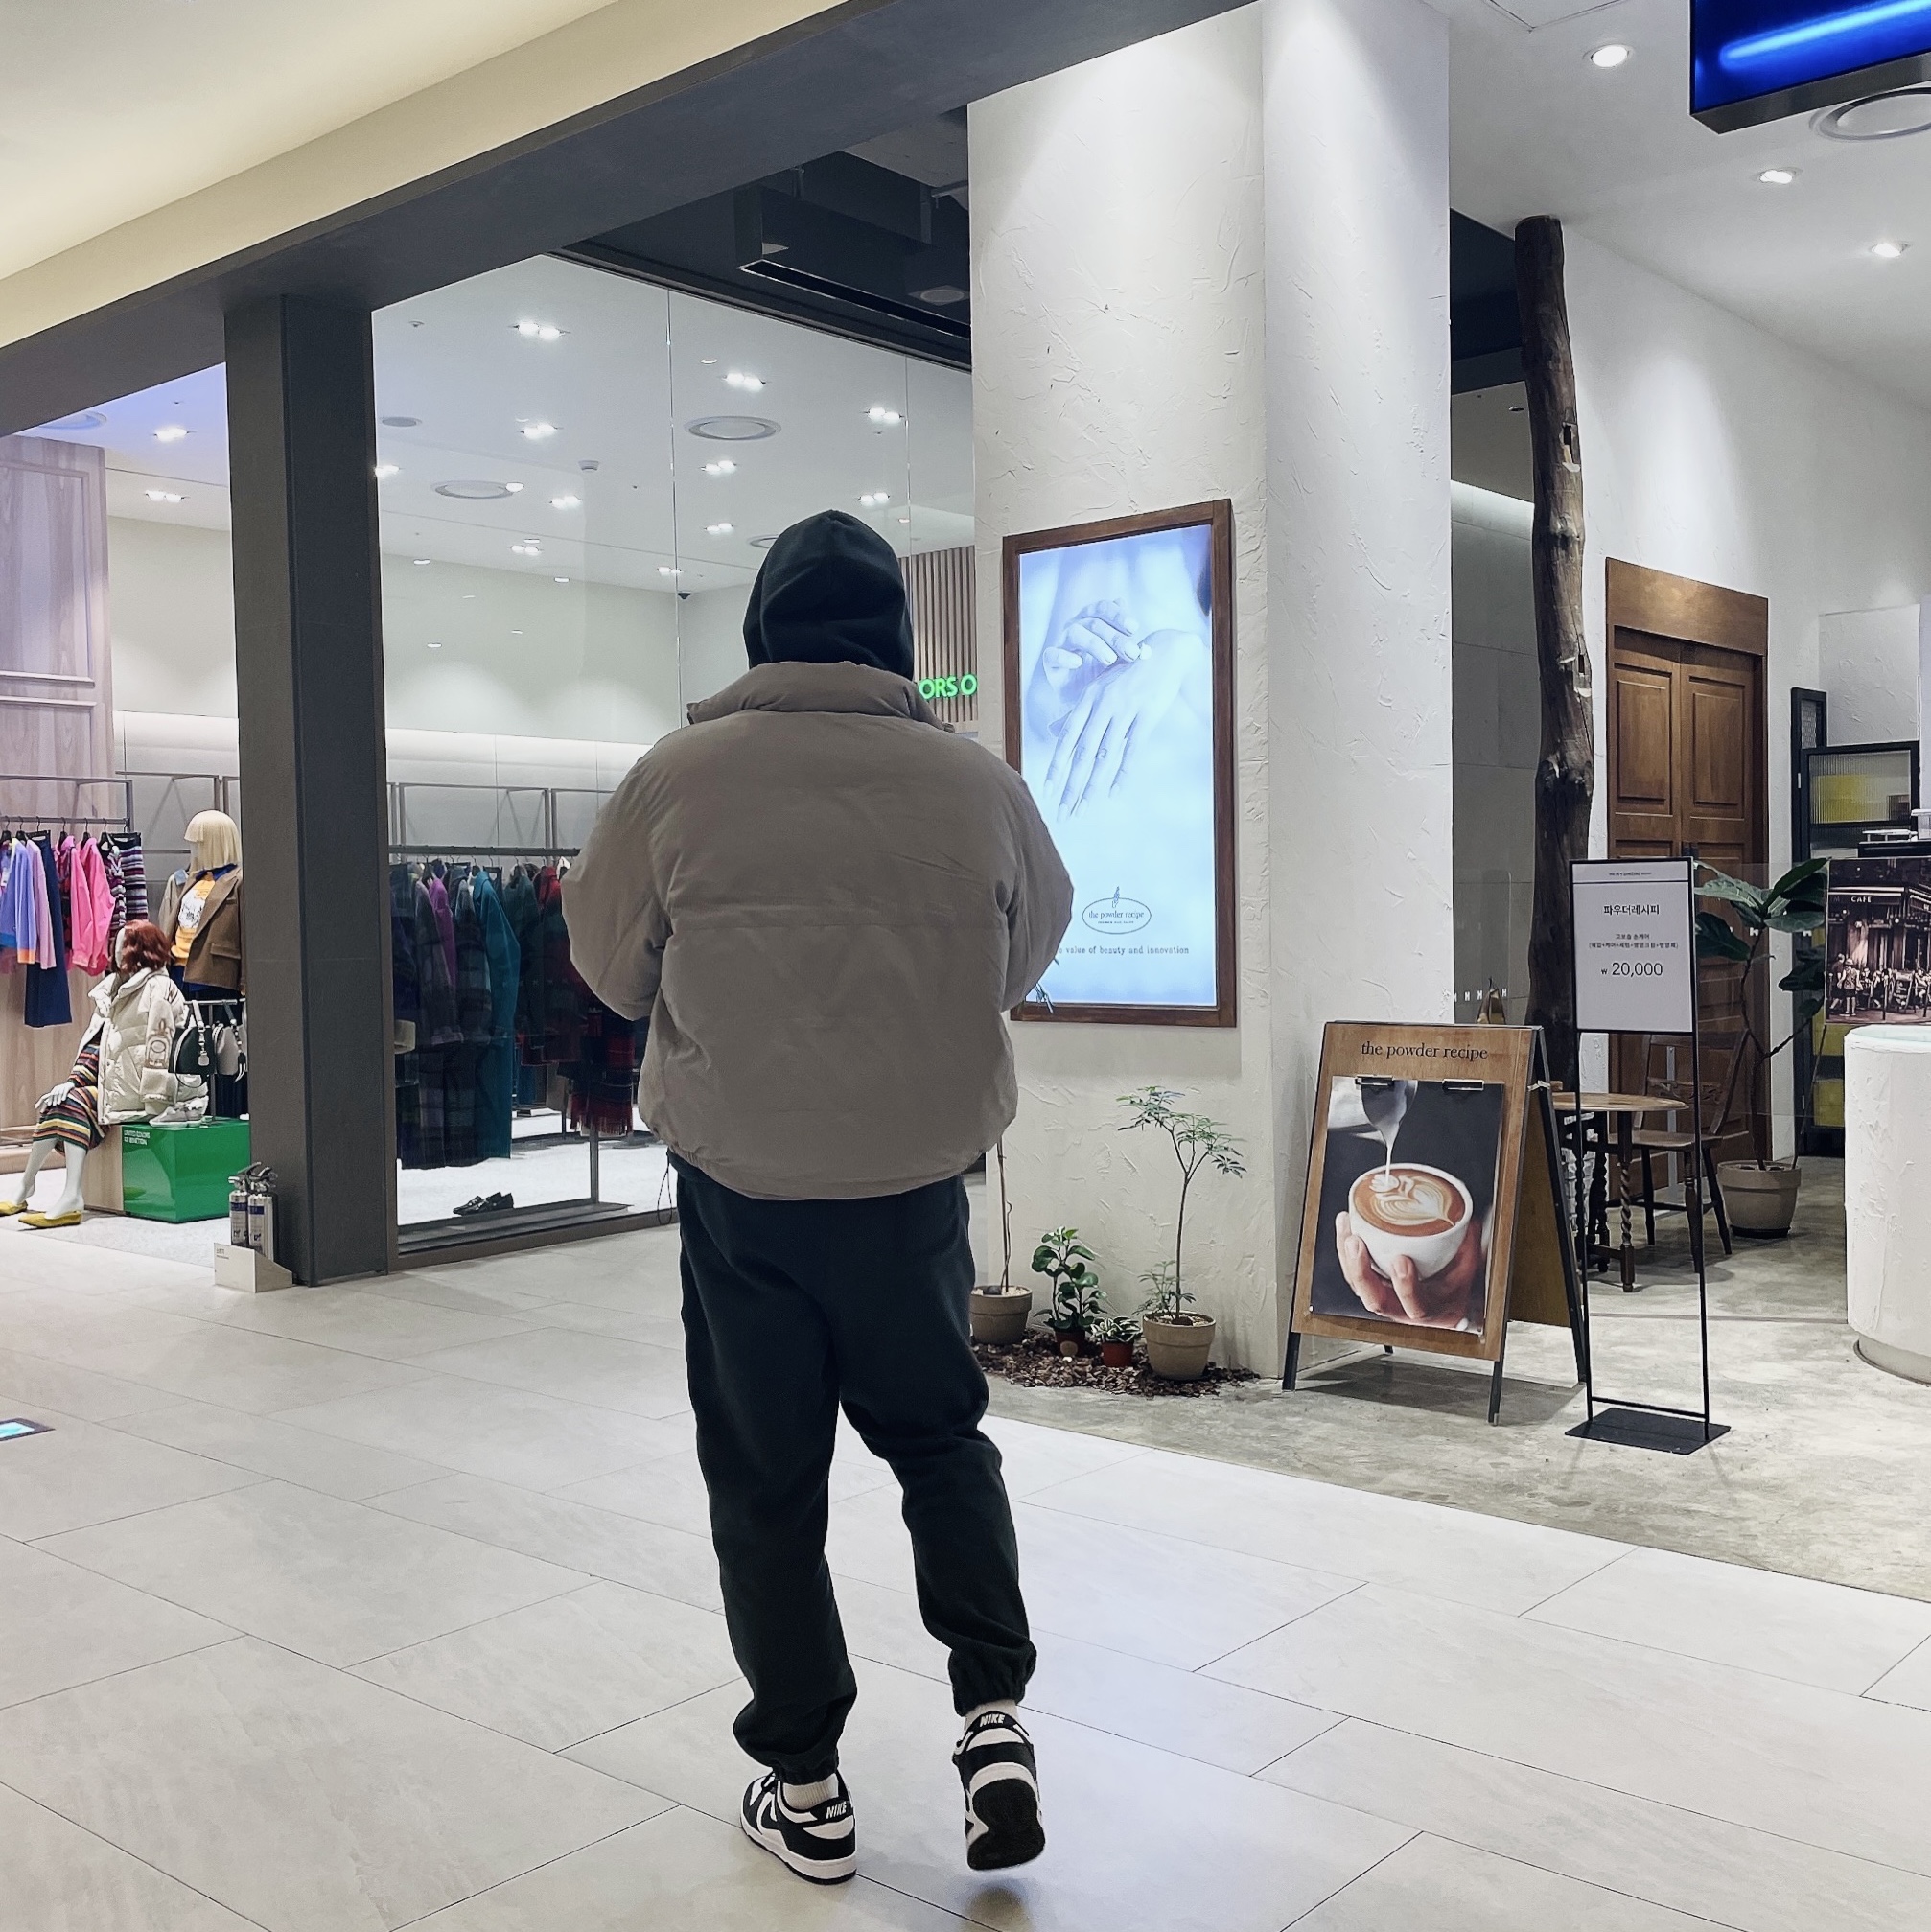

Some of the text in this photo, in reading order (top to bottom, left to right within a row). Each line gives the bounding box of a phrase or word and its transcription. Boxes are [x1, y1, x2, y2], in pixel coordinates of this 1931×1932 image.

[1088, 910, 1145, 919] the powder recipe
[1603, 904, 1660, 916] 파우더레시피
[1066, 945, 1086, 954] value
[1088, 945, 1097, 954] of
[1100, 945, 1126, 956] beauty
[1128, 945, 1144, 954] and
[1147, 945, 1189, 954] innovation
[1612, 962, 1663, 977] 20,000
[1361, 1040, 1488, 1062] the powder recipe
[979, 1713, 1005, 1728] NIKE
[826, 1800, 847, 1820] NIKE
